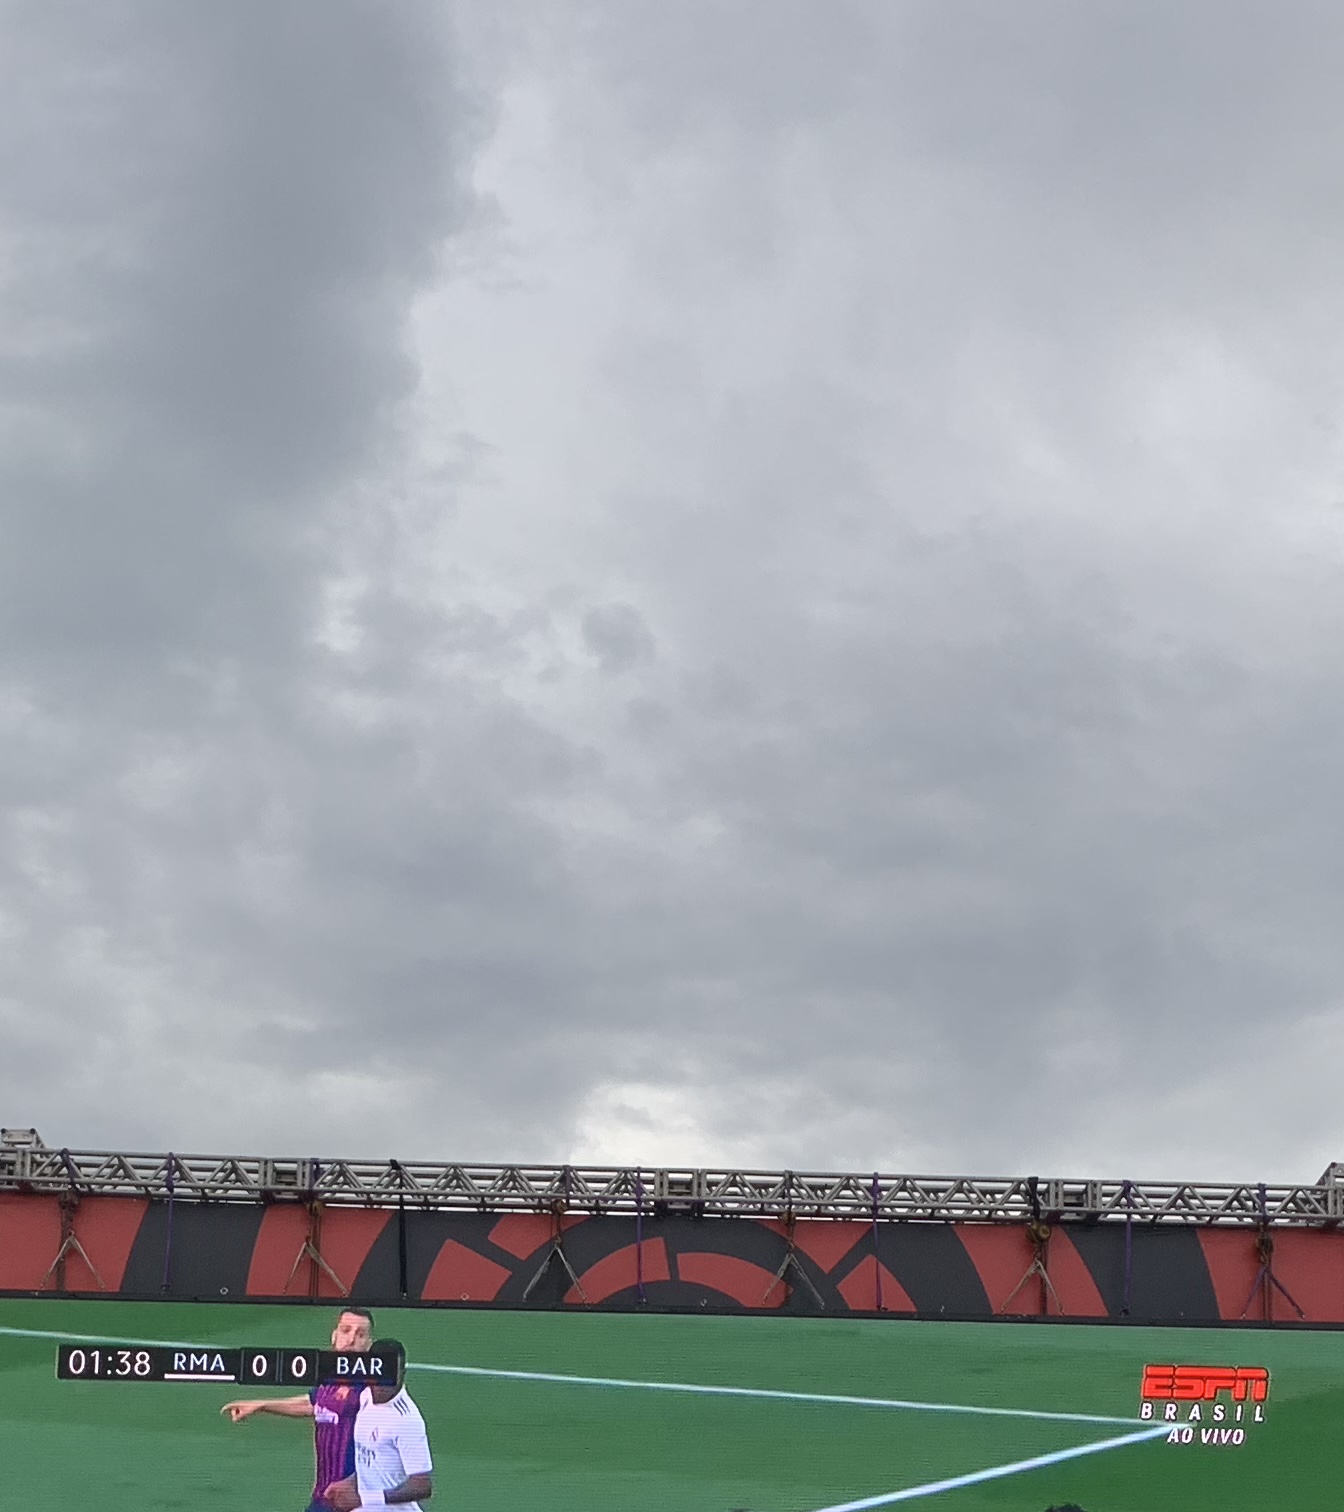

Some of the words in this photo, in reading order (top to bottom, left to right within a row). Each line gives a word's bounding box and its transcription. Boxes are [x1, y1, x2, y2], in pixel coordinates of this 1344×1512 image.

[68, 1349, 151, 1376] 01:38
[174, 1353, 226, 1372] RMA
[252, 1354, 268, 1377] 0
[291, 1355, 307, 1378] 0
[336, 1356, 384, 1376] BAR
[1141, 1363, 1270, 1402] ESPN
[1141, 1401, 1265, 1423] BRASIL
[1167, 1427, 1194, 1444] AO
[1200, 1428, 1245, 1445] VIVO
